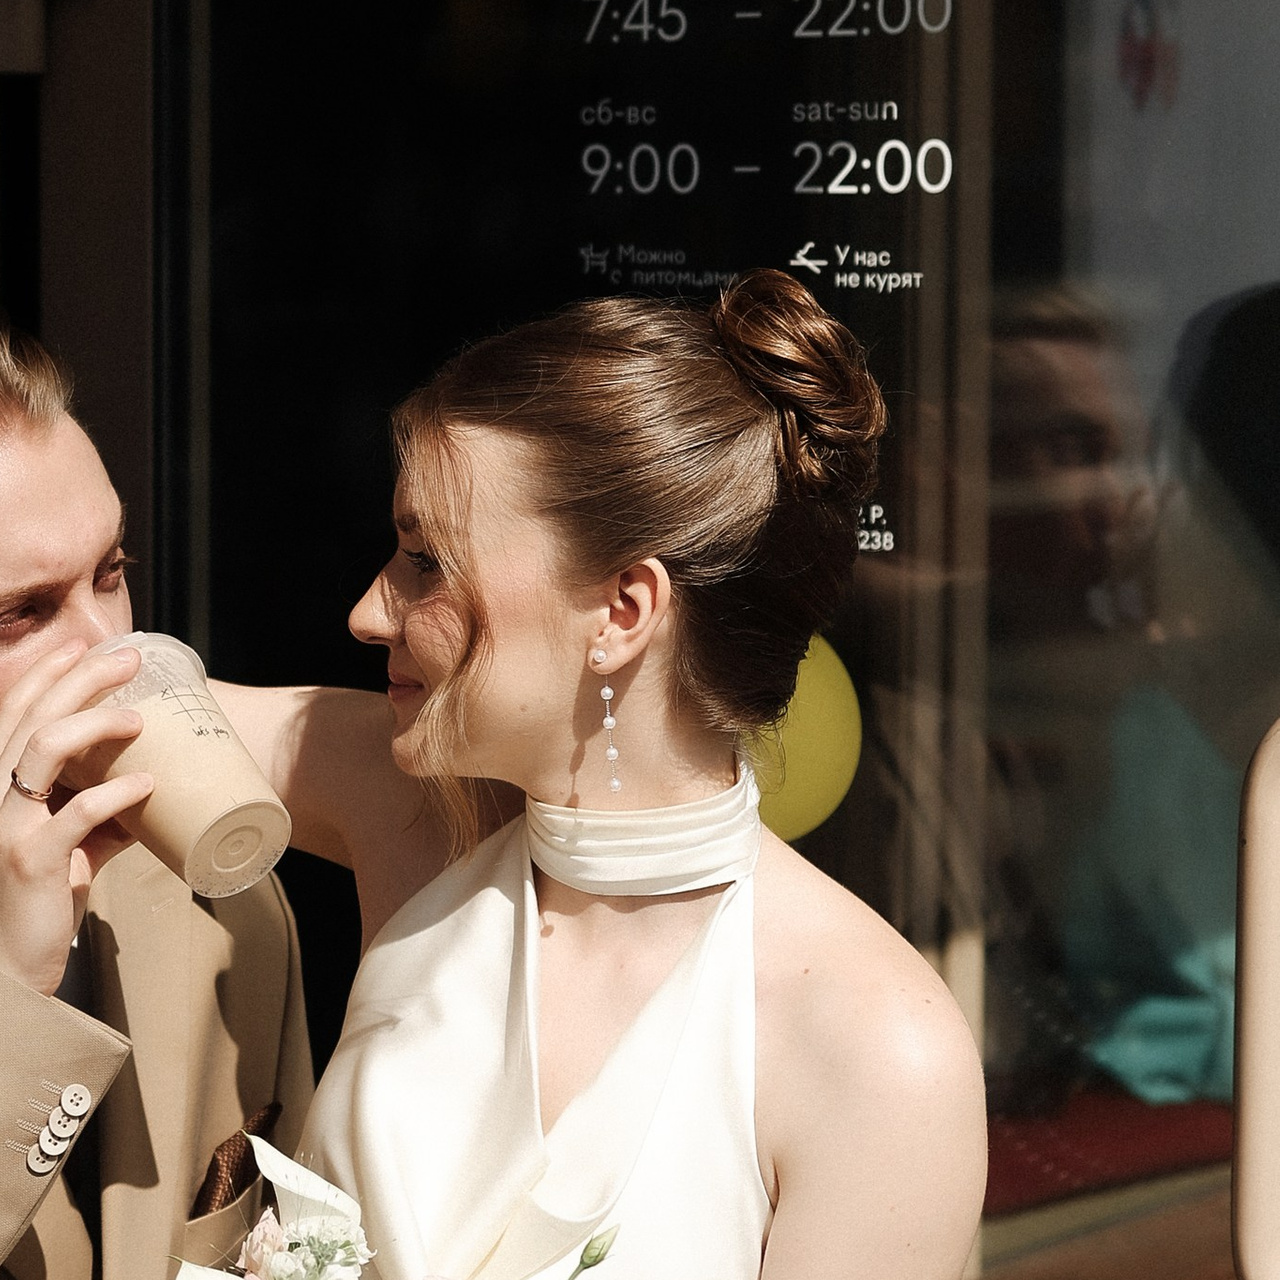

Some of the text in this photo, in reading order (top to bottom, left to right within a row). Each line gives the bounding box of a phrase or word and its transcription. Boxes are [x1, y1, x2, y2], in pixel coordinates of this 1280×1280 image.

[579, 96, 658, 127] сб-вс
[792, 99, 900, 123] sat-sun
[580, 142, 701, 195] 9:00
[792, 137, 953, 196] 22:00
[617, 244, 687, 265] Можно
[834, 244, 892, 268] У нас
[835, 271, 924, 294] не курят
